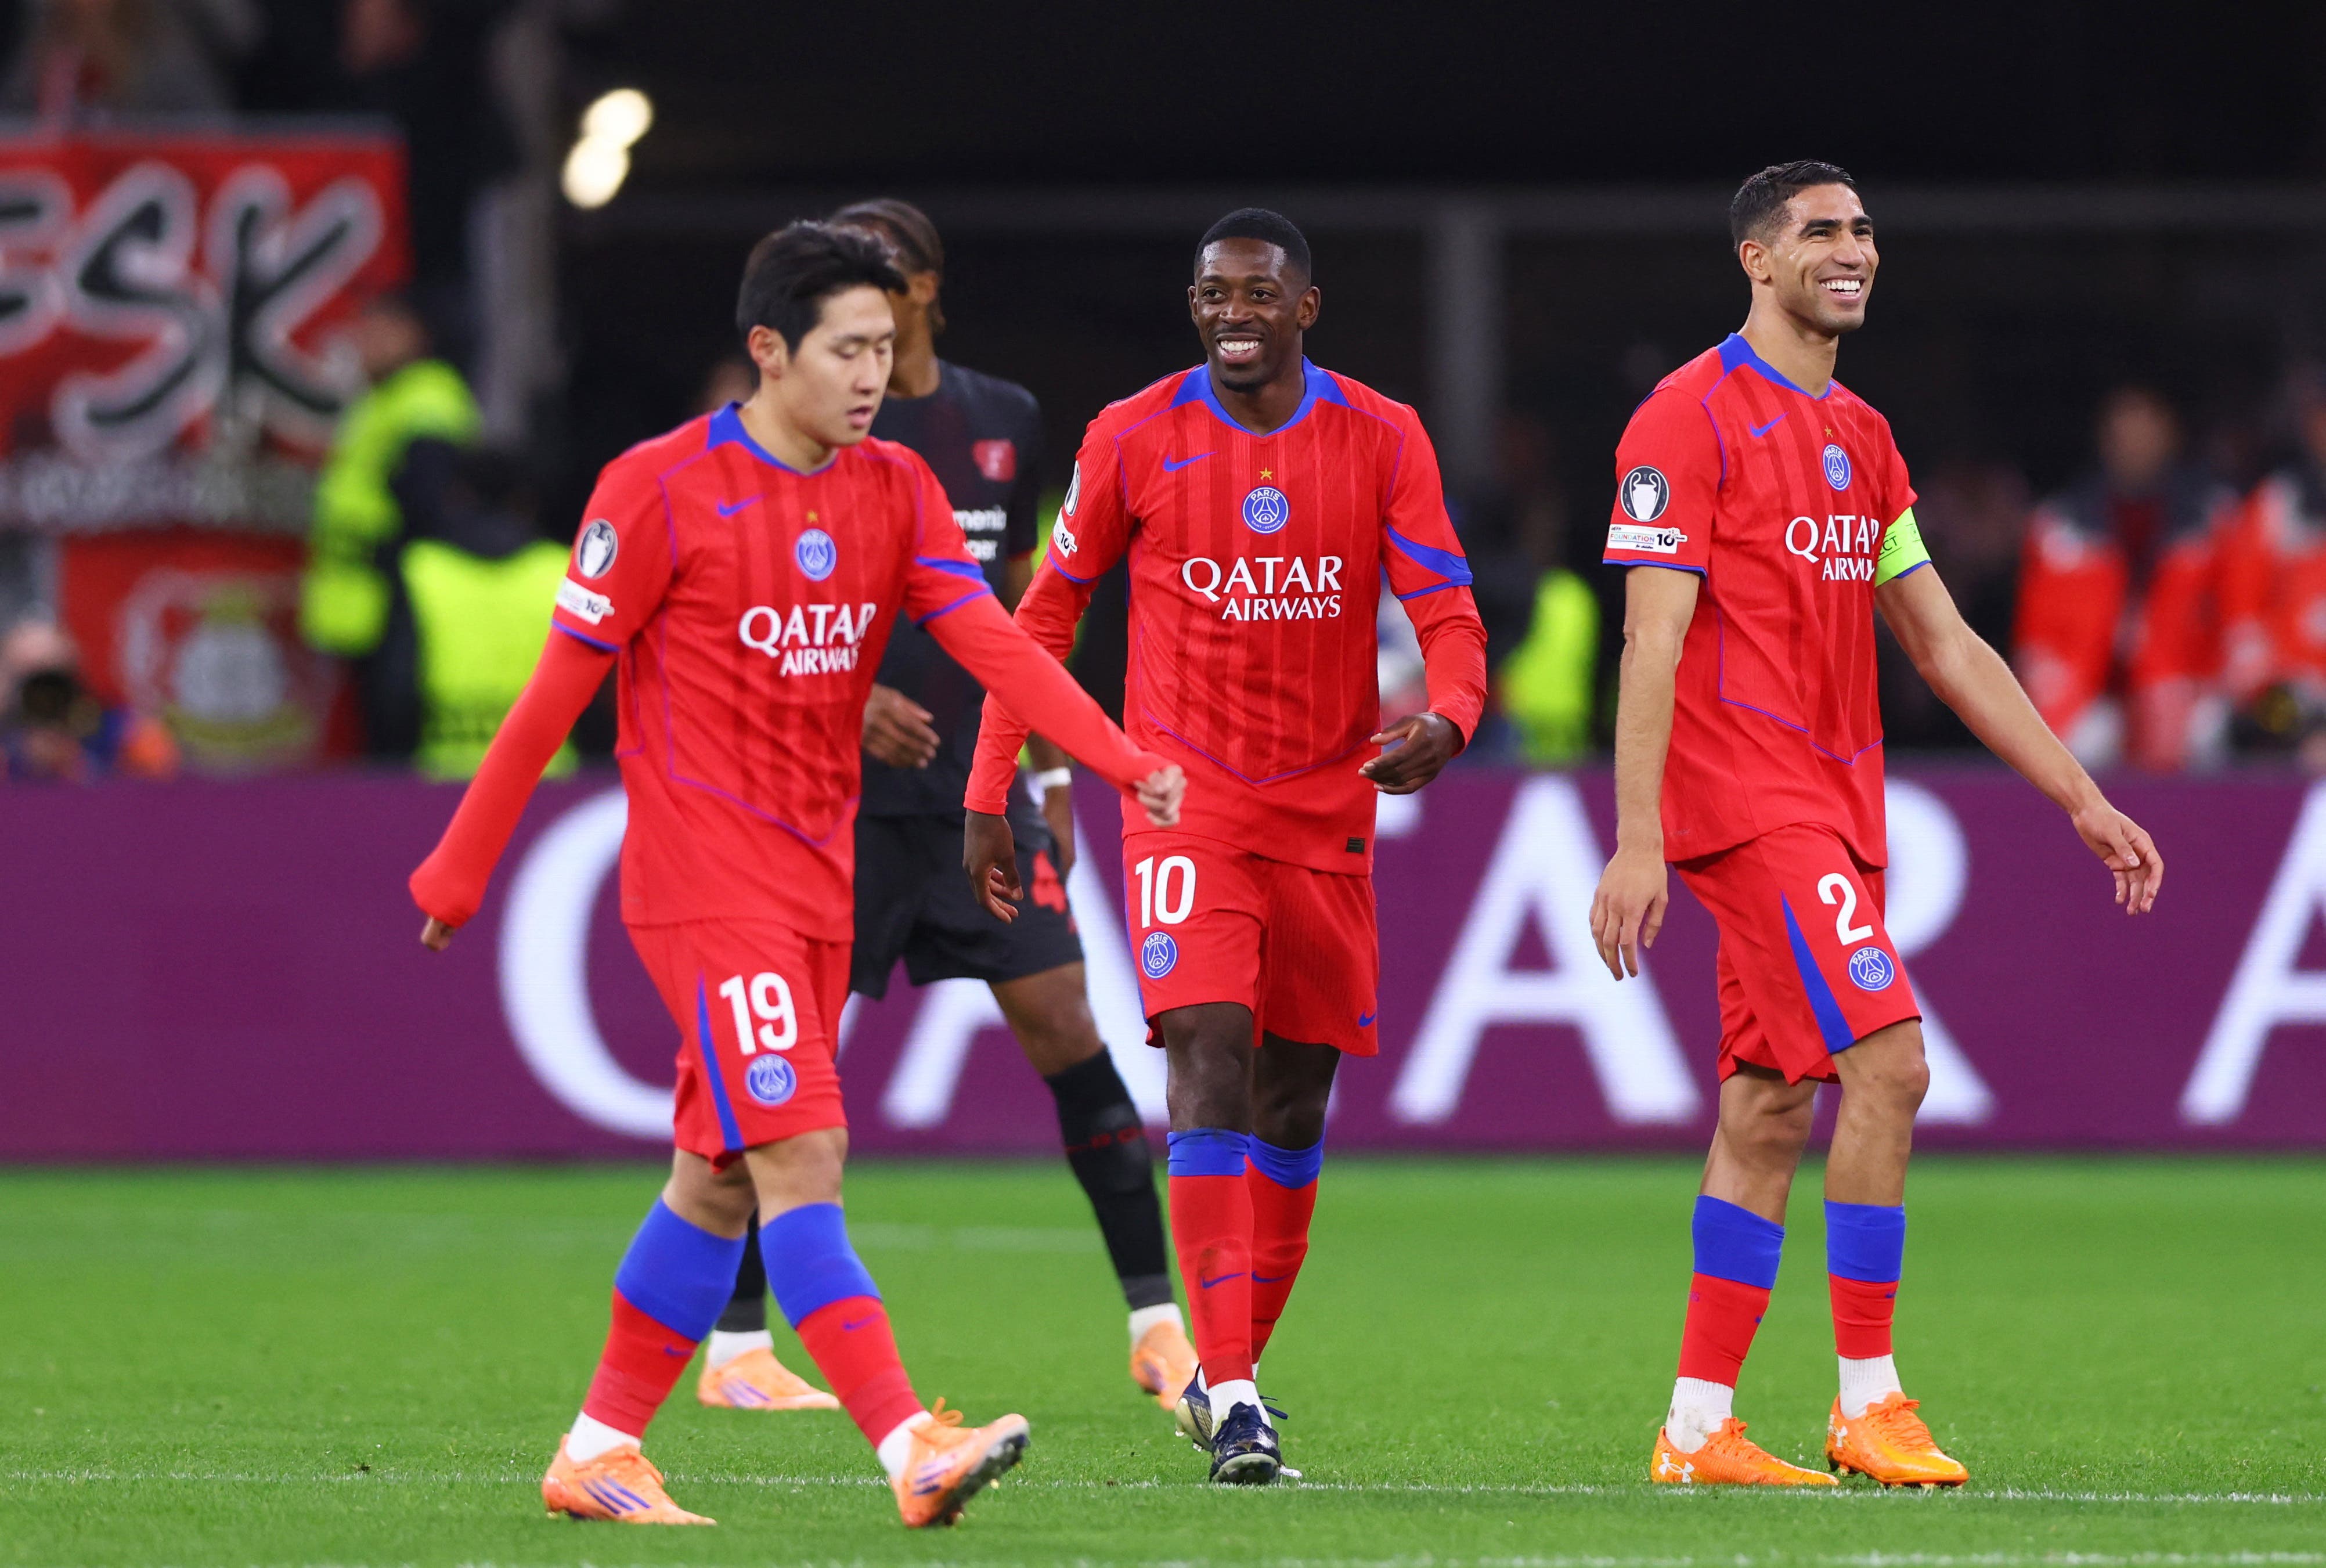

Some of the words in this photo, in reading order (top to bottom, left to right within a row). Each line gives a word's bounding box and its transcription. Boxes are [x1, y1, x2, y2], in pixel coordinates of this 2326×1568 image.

[1824, 447, 1842, 457] PARIS
[1250, 489, 1280, 500] PARIS
[1610, 534, 1654, 542] FOUNDATION
[1657, 533, 1675, 546] 10
[1182, 556, 1343, 603] QATAR
[1221, 594, 1341, 621] AIRWAYS
[780, 642, 861, 677] AIRWA
[1135, 855, 1196, 929] 10
[1817, 873, 1874, 946] 2
[1146, 935, 1168, 948] PARIS
[1852, 949, 1879, 965] PARIS
[718, 971, 798, 1056] 19
